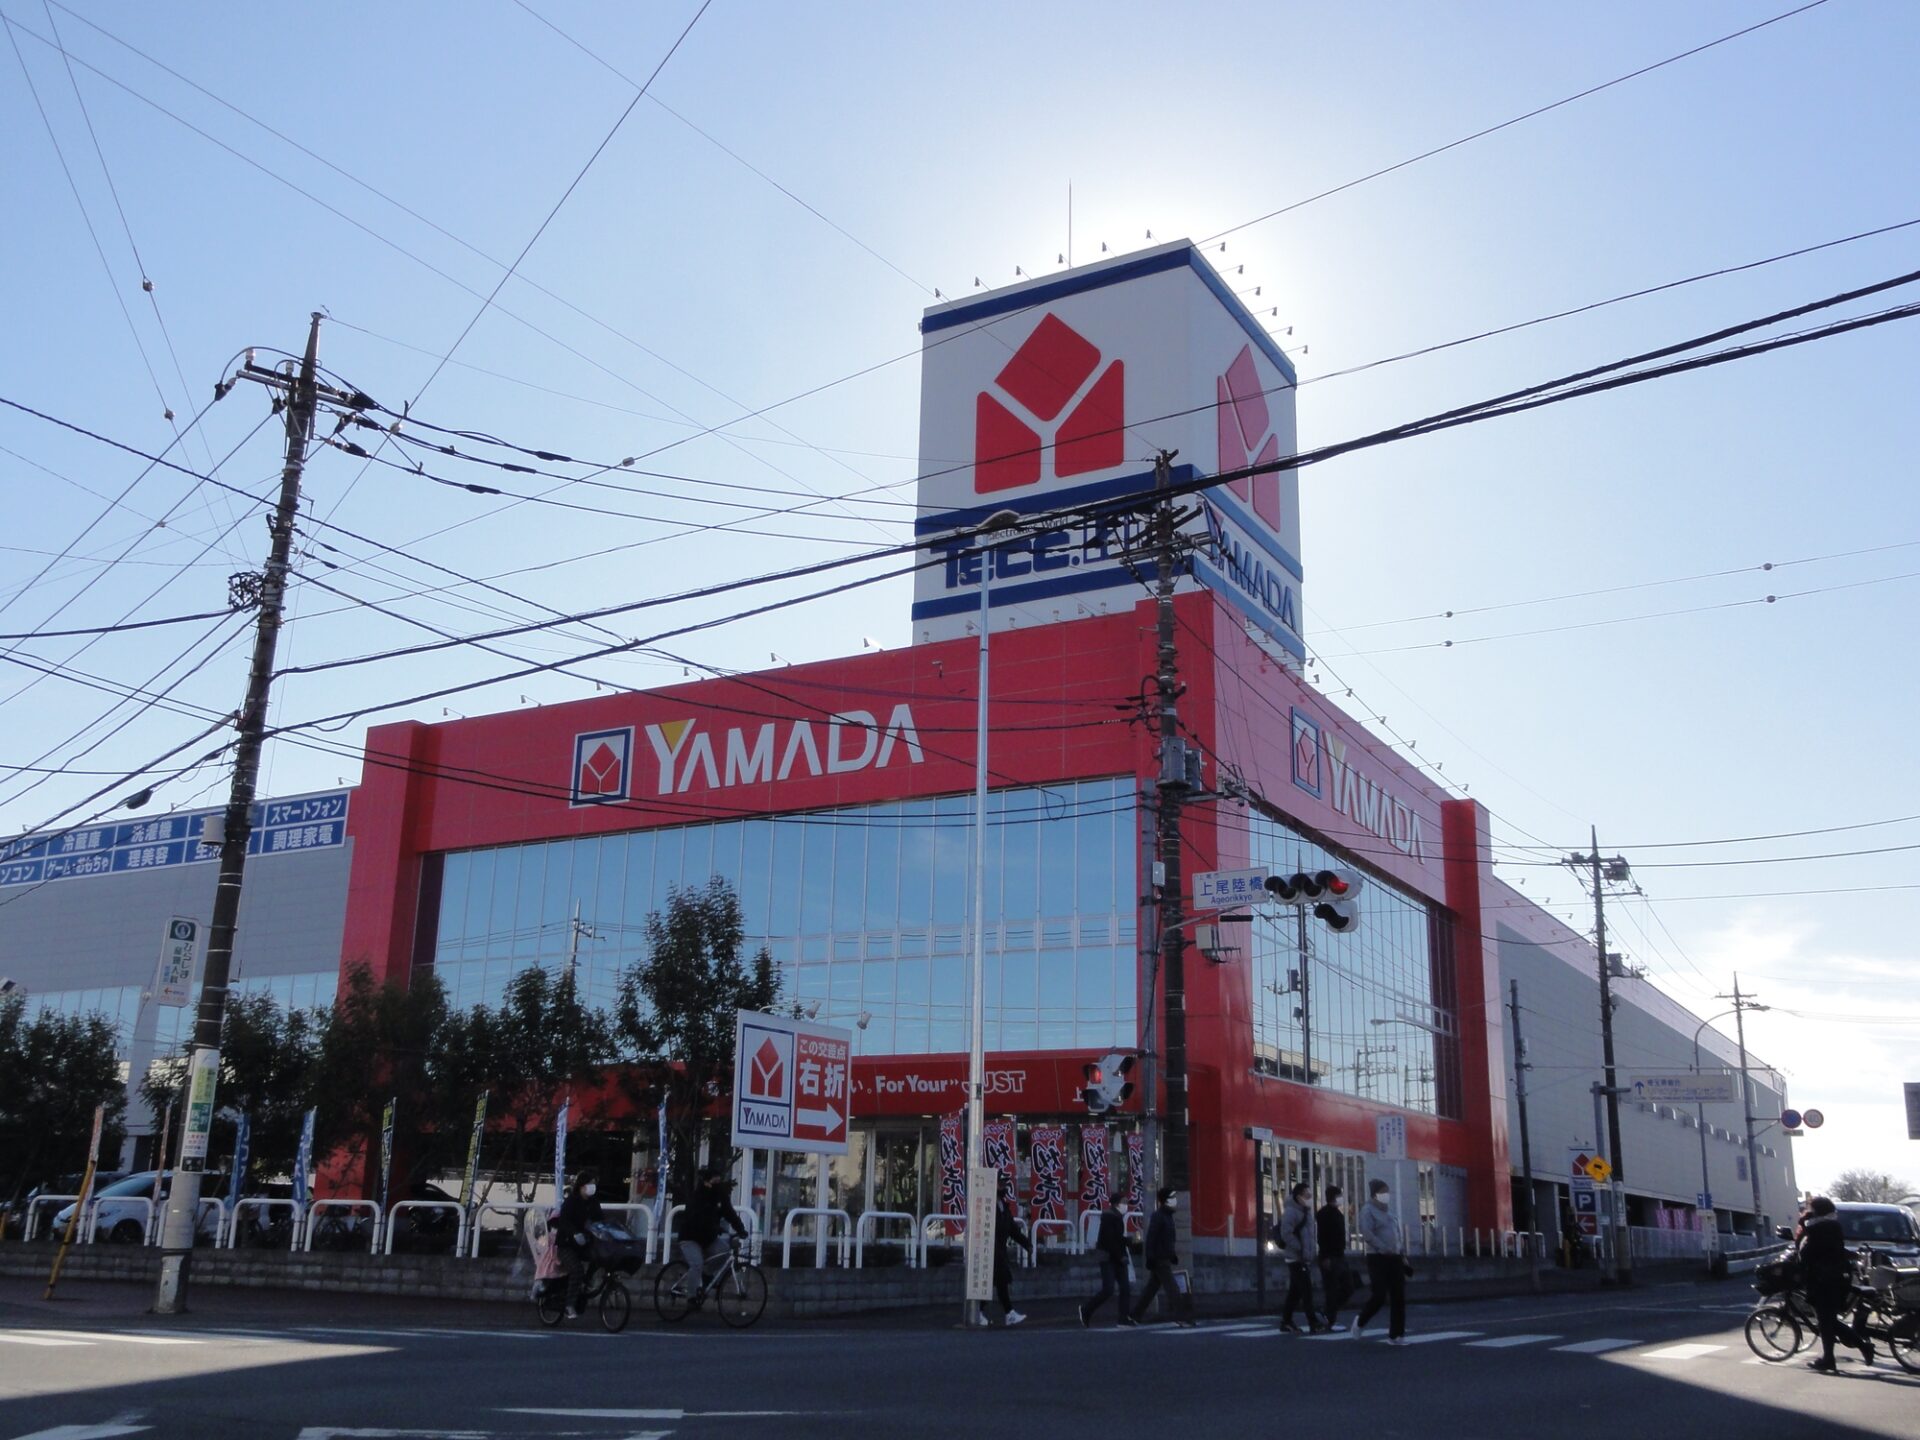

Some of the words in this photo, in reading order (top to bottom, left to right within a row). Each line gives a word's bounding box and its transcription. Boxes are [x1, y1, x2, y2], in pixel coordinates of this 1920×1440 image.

[1203, 499, 1297, 632] YAMADA
[644, 703, 925, 795] YAMADA
[270, 793, 342, 824] スマートフォン
[1321, 729, 1425, 867] YAMADA
[62, 831, 102, 852] 冷蔵庫
[130, 820, 172, 842] 洗濯機
[272, 824, 334, 850] 調理家電
[47, 855, 109, 878] ゲーム・おもちゃ
[127, 845, 169, 868] 理美容
[1200, 875, 1264, 897] 上尾陸橋
[799, 1039, 846, 1061] この交差点
[799, 1058, 845, 1099] 右折
[875, 1075, 905, 1093] For
[743, 1106, 786, 1129] YAMADA
